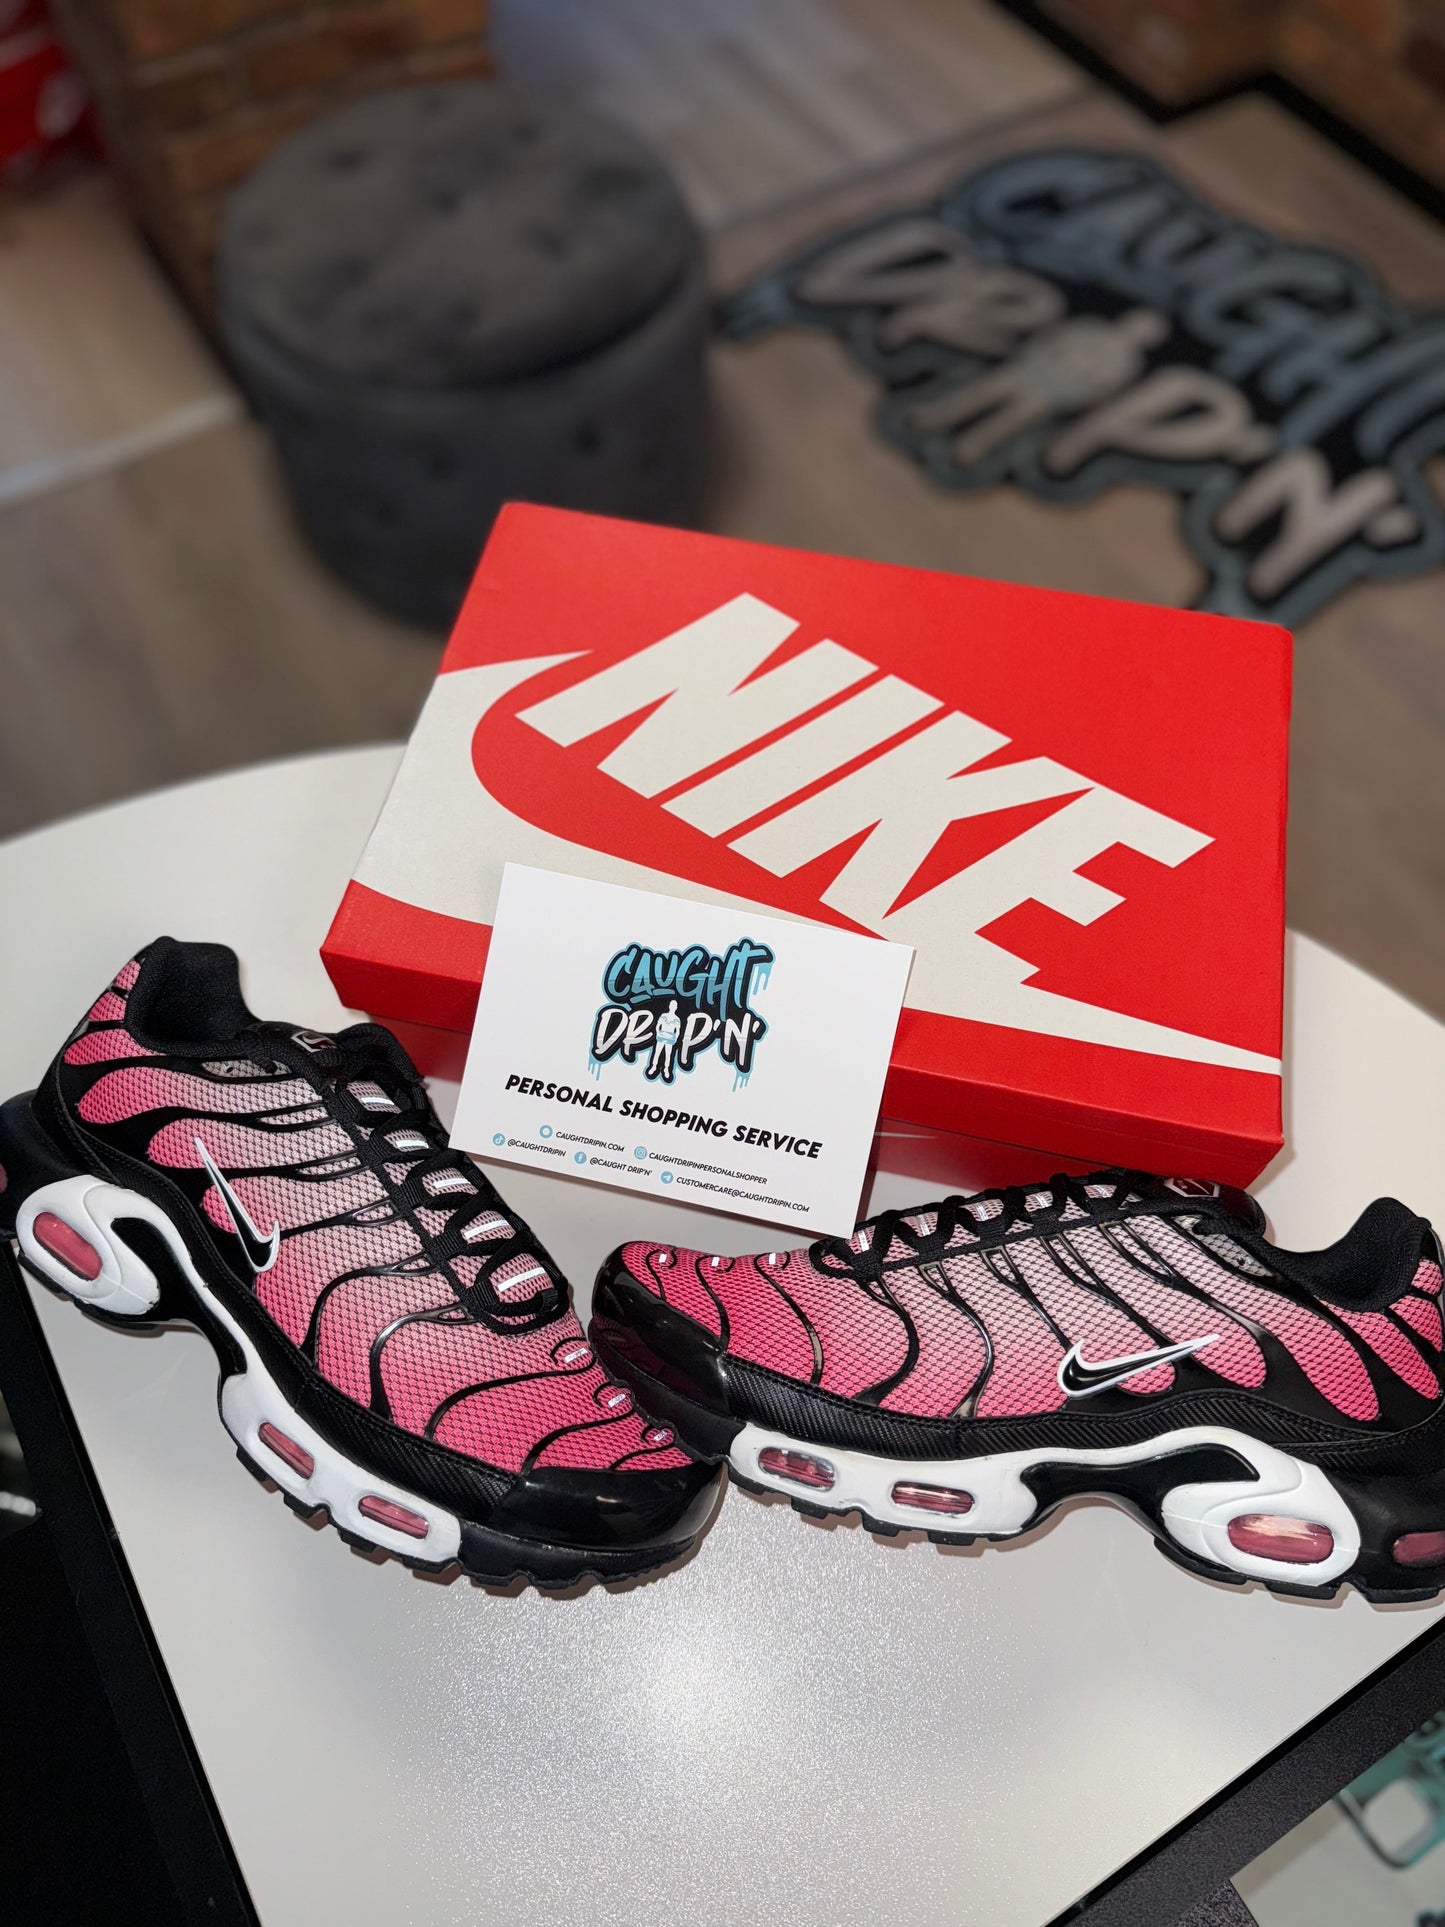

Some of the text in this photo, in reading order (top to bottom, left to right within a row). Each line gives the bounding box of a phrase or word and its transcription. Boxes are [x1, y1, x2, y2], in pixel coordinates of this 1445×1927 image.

[515, 592, 1215, 984] NIKE
[605, 942, 768, 1022] CAUGHT
[504, 1074, 823, 1159] PERSONAL SHOPPING SERVICE
[507, 1139, 567, 1157] @CAUGHTDRIPIN
[555, 1131, 626, 1152] CAUGHTDRIPIN.COM
[589, 1157, 627, 1171] @CAUGHT
[649, 1152, 768, 1185] CAUGHTDRIPINPERSONALSHOPPER
[676, 1176, 810, 1213] CUSTOMERCARE@CAUGHTDRIPIN.COM
